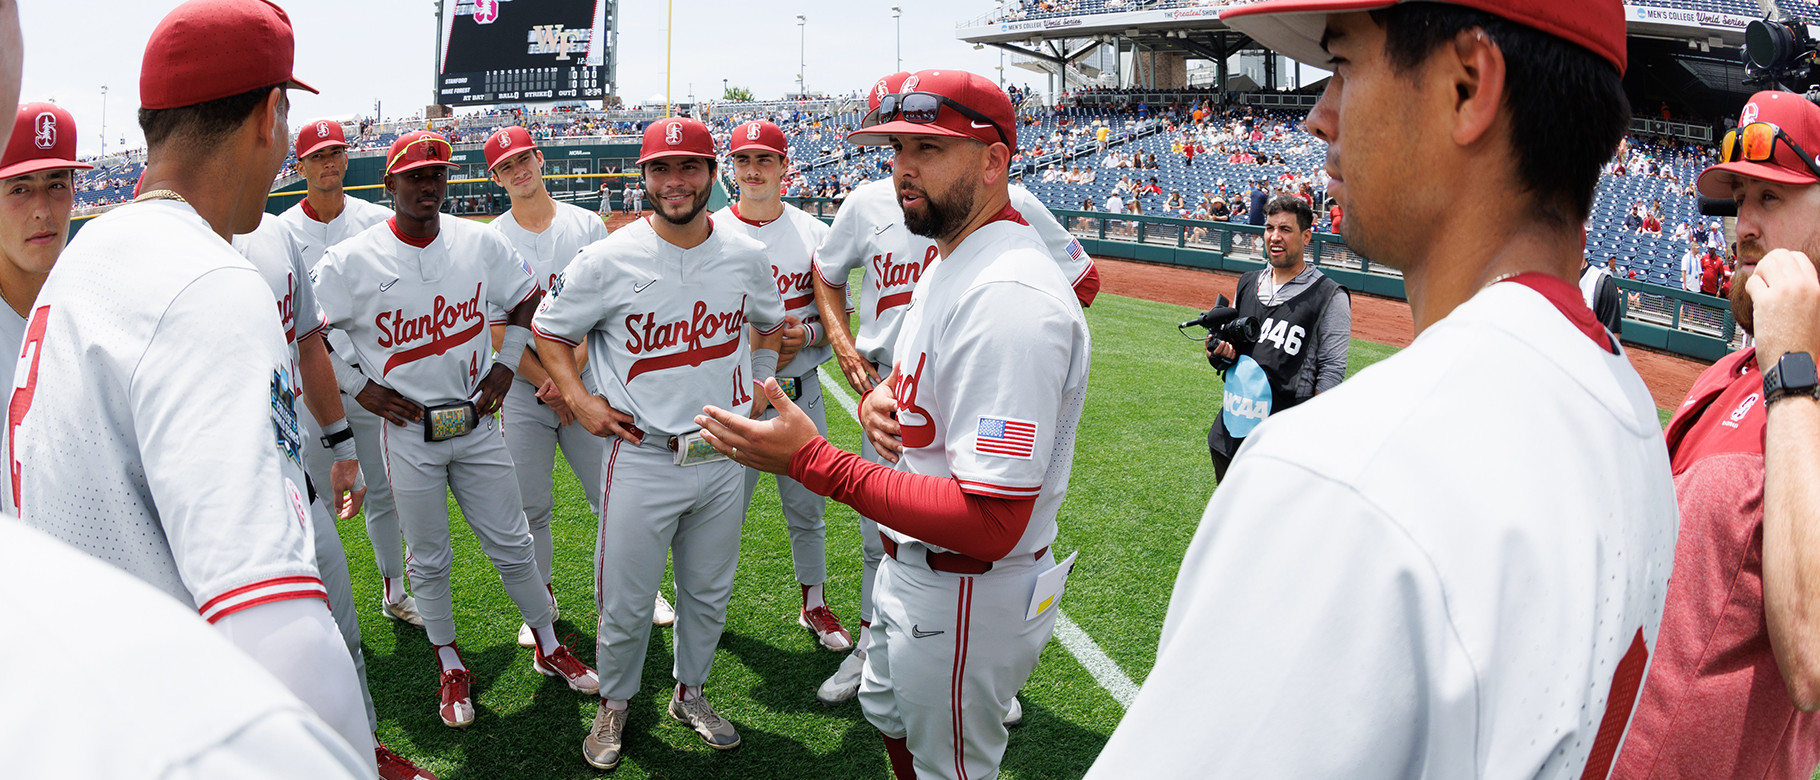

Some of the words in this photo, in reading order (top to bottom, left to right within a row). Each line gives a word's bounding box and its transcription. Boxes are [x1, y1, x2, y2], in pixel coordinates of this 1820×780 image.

[1647, 10, 1667, 19] MEN'S
[1668, 11, 1694, 22] COLLEGE
[1696, 12, 1720, 24] World
[375, 282, 483, 348] Stanford
[624, 294, 748, 354] Stanford
[469, 350, 479, 387] 4
[732, 365, 752, 407] 11
[1223, 390, 1269, 422] NCAA
